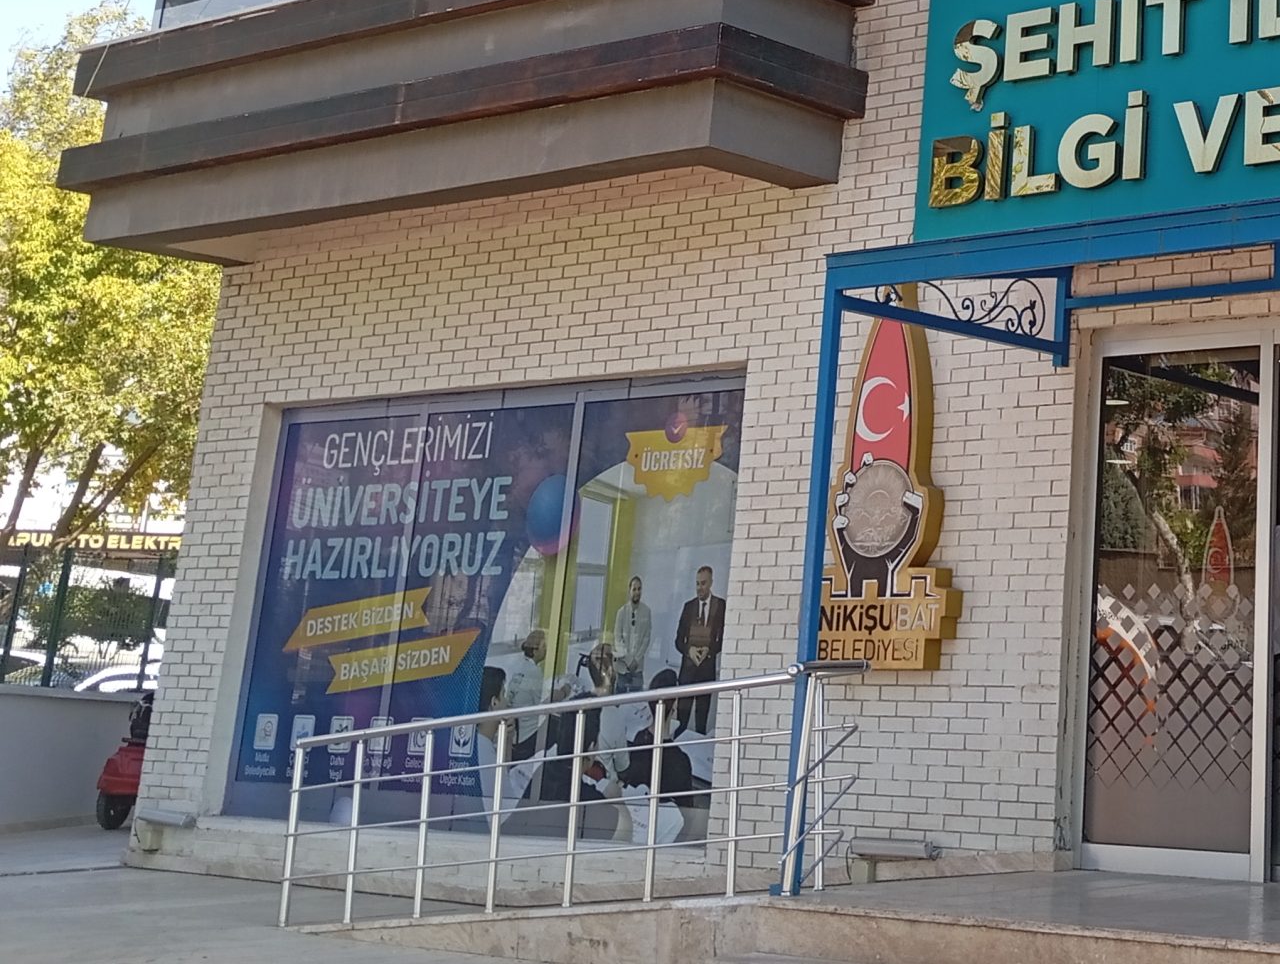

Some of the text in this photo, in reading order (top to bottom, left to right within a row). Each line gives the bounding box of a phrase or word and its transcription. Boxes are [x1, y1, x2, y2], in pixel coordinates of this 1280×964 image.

[928, 89, 1149, 209] BİLGİ
[323, 412, 495, 476] GENÇLERİMİZİ
[642, 444, 706, 472] ÜCRETSİZ
[292, 470, 513, 529] ÜNİVERSİTEYE
[282, 531, 506, 580] HAZIRLIYORUZ
[306, 602, 414, 636] DESTEK BİZDEN
[819, 604, 939, 635] NİKİŞUBAT
[340, 646, 450, 683] BAŞARI SİZDEN
[818, 638, 919, 661] BELEDİYESİ
